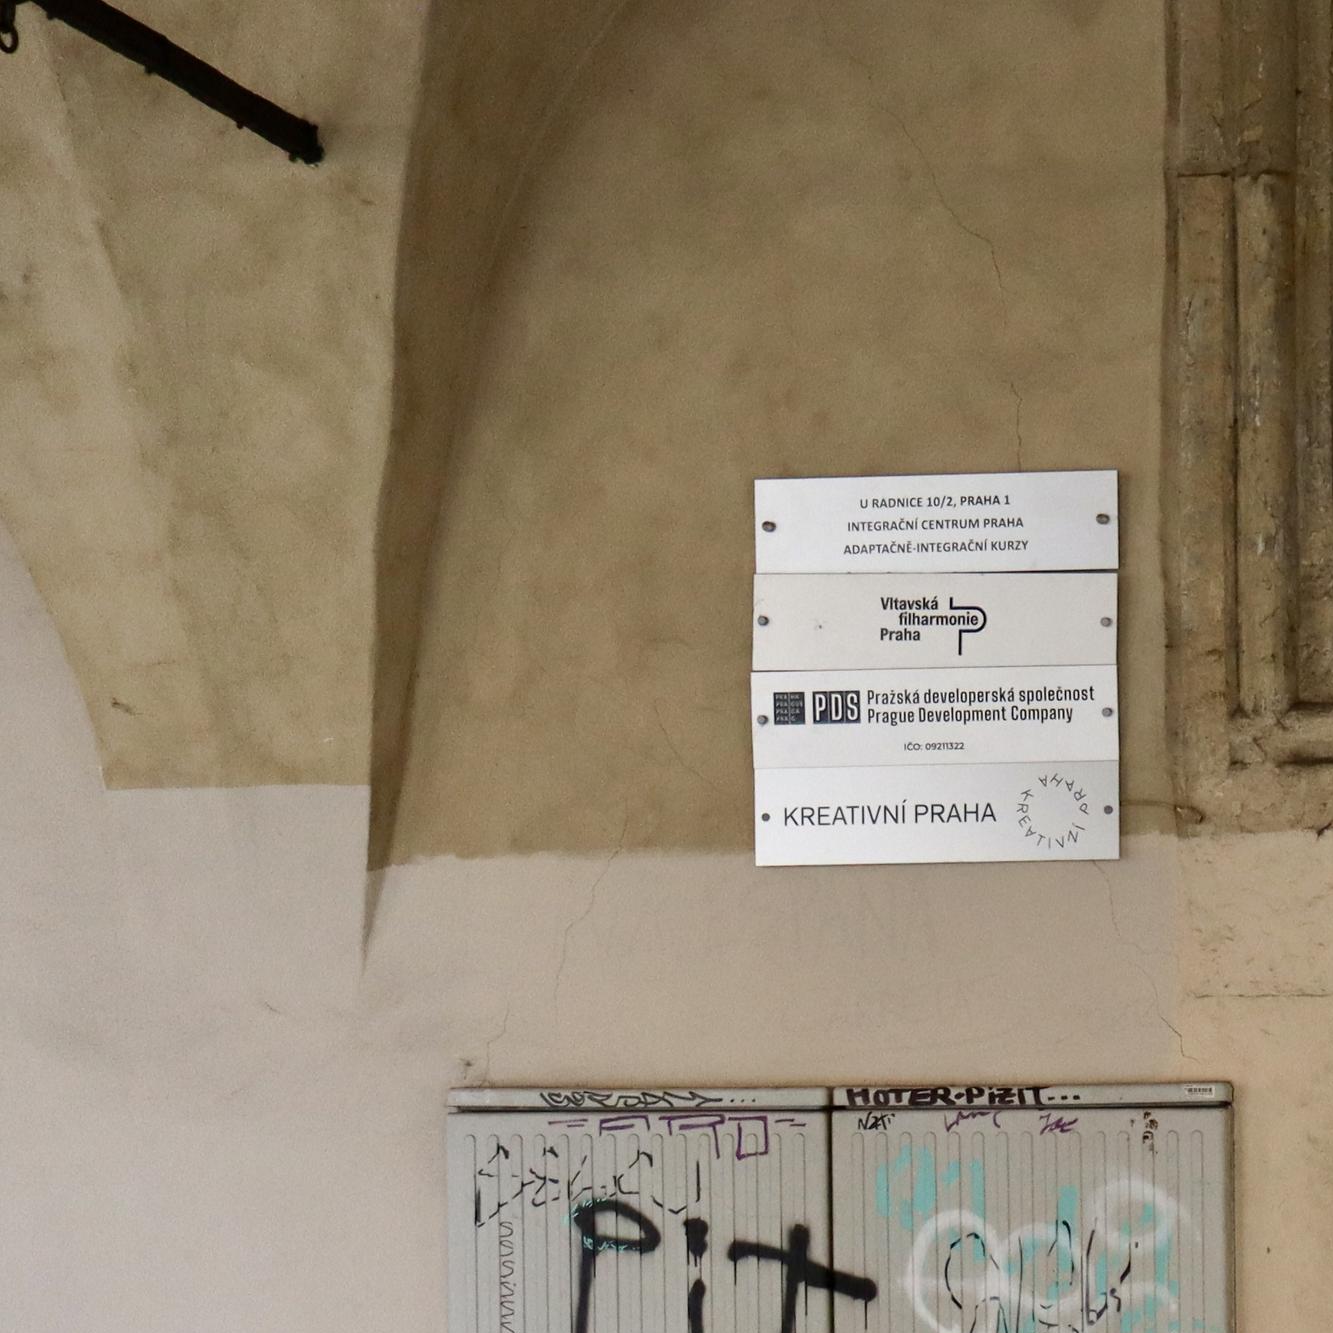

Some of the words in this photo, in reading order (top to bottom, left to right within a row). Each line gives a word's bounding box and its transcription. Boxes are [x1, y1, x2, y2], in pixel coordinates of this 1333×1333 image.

[860, 499, 869, 509] U
[872, 497, 923, 508] RADNICE
[927, 496, 957, 508] 10/2,
[960, 495, 1001, 506] PRAHA
[1004, 495, 1010, 505] 1
[847, 517, 918, 532] INTEGRAČNÍ
[921, 519, 980, 530] CENTRUM
[983, 517, 1024, 529] PRAHA
[991, 540, 1029, 552] KURZY
[880, 596, 938, 610] Vltavská
[899, 611, 979, 626] filharmonie
[880, 627, 921, 641] Praha
[867, 689, 920, 705] Pražská
[923, 687, 1015, 706] developerská
[1019, 686, 1095, 705] společnost
[814, 693, 859, 721] PDS
[868, 708, 914, 727] Prague
[919, 706, 1007, 725] Development
[1011, 705, 1073, 724] Company
[904, 742, 923, 751] IČO:
[925, 742, 965, 750] 09211322
[783, 800, 908, 827] KREATIVNÍ
[914, 802, 997, 824] PRAHA
